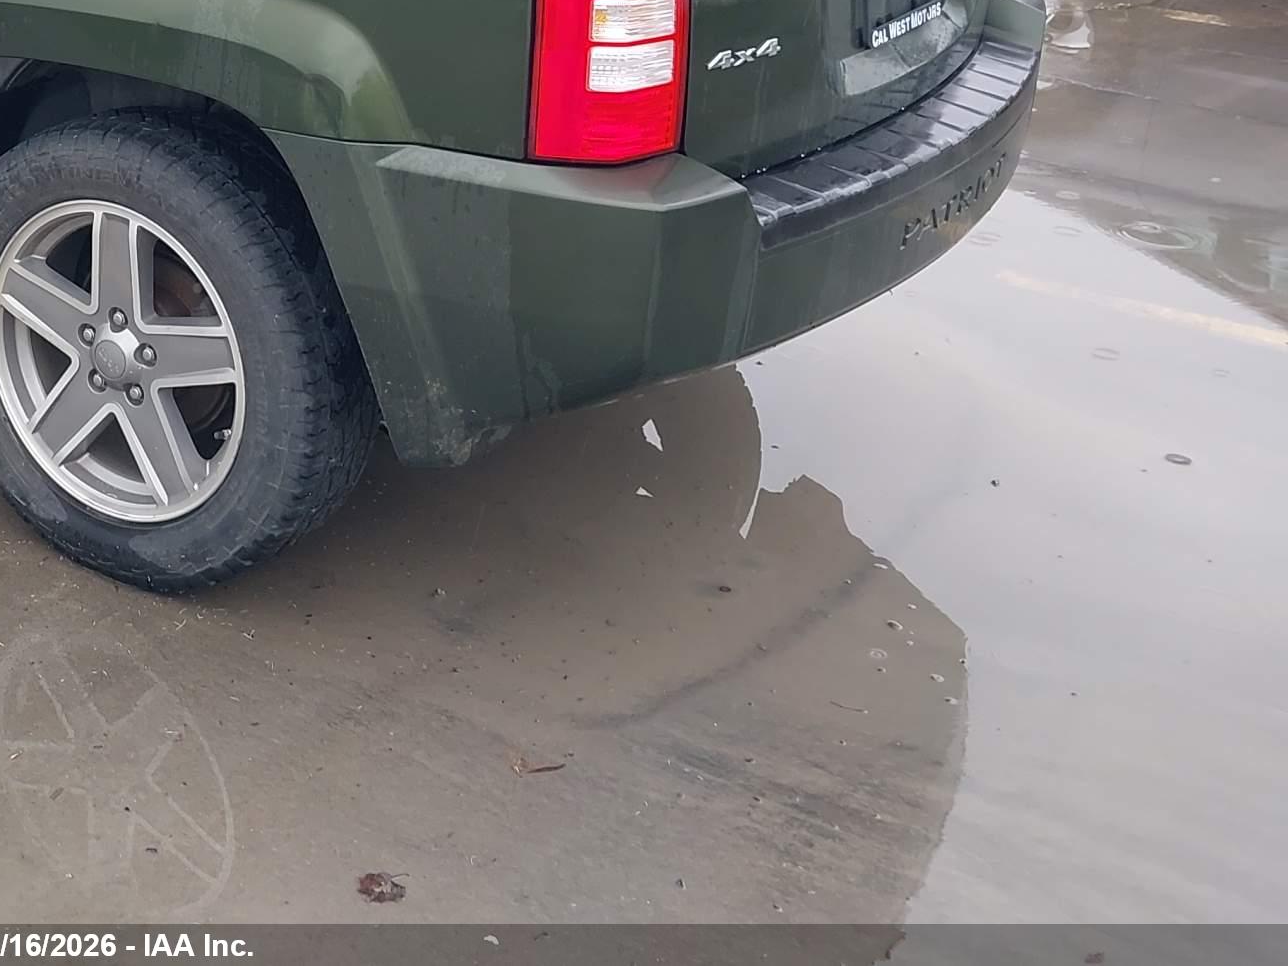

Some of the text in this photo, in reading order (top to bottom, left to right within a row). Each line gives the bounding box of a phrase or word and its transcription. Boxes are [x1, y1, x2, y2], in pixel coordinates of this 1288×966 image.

[872, 1, 942, 48] CAL WEST MOTORS
